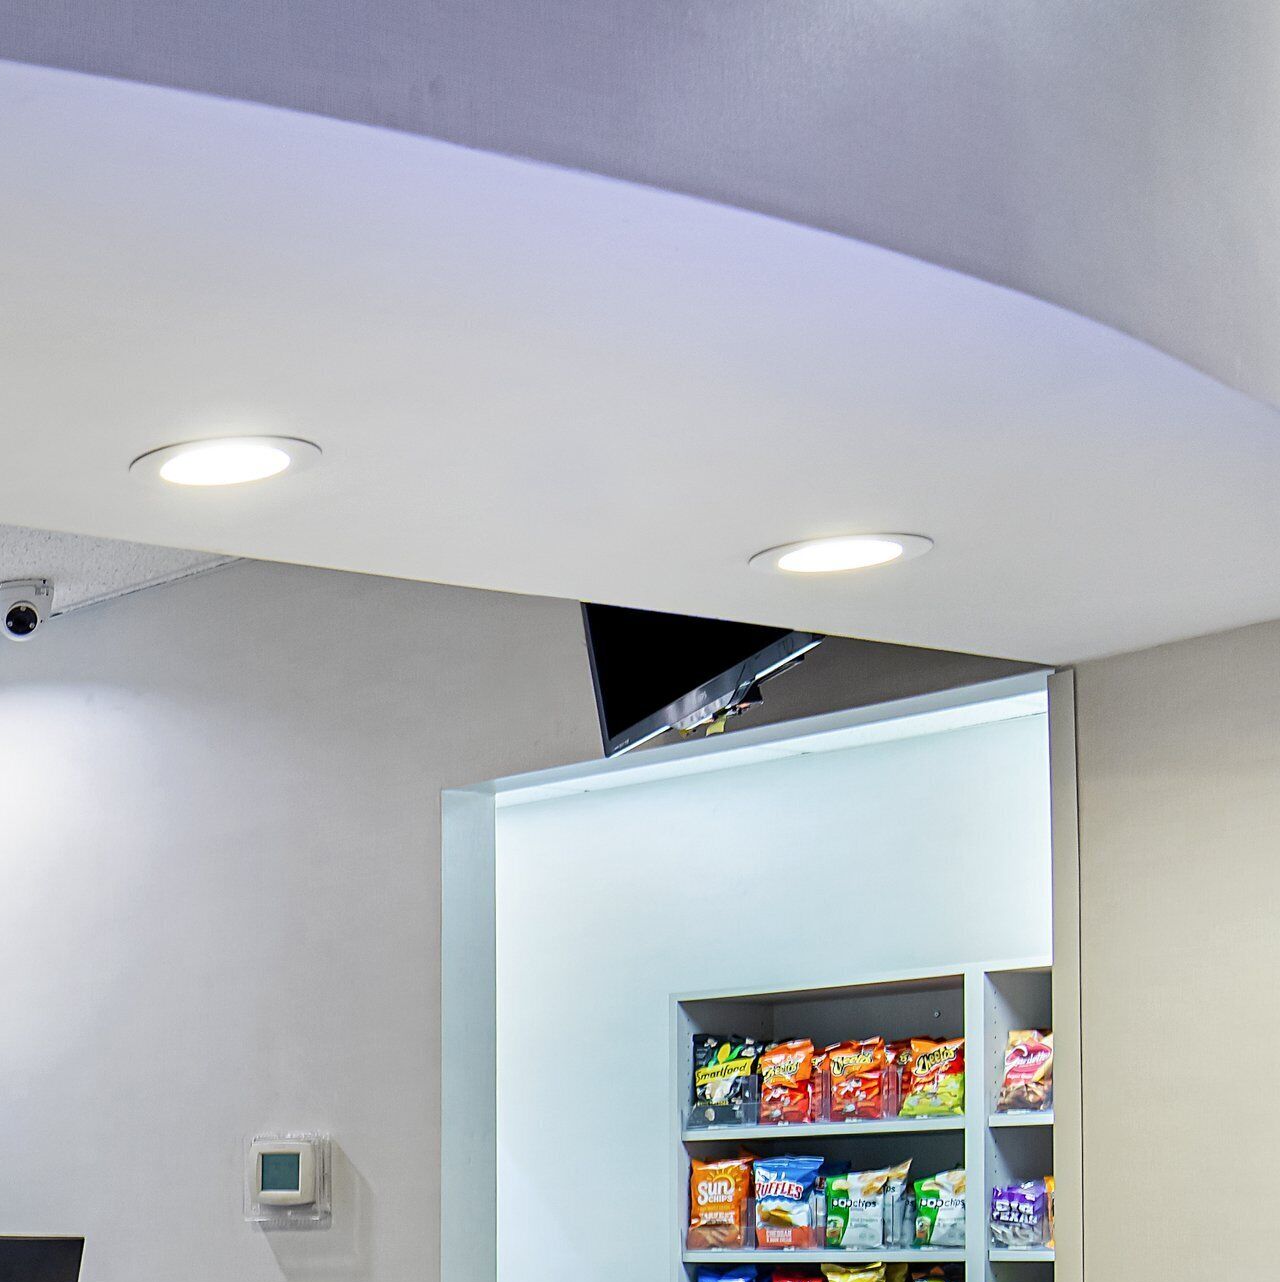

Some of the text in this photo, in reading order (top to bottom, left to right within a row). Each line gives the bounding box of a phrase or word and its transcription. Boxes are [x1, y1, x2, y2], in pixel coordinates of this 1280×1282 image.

[912, 1045, 958, 1076] Cheetos
[696, 1062, 747, 1082] Smartfood
[756, 1180, 803, 1199] RUFFLES
[832, 1198, 877, 1209] popchips
